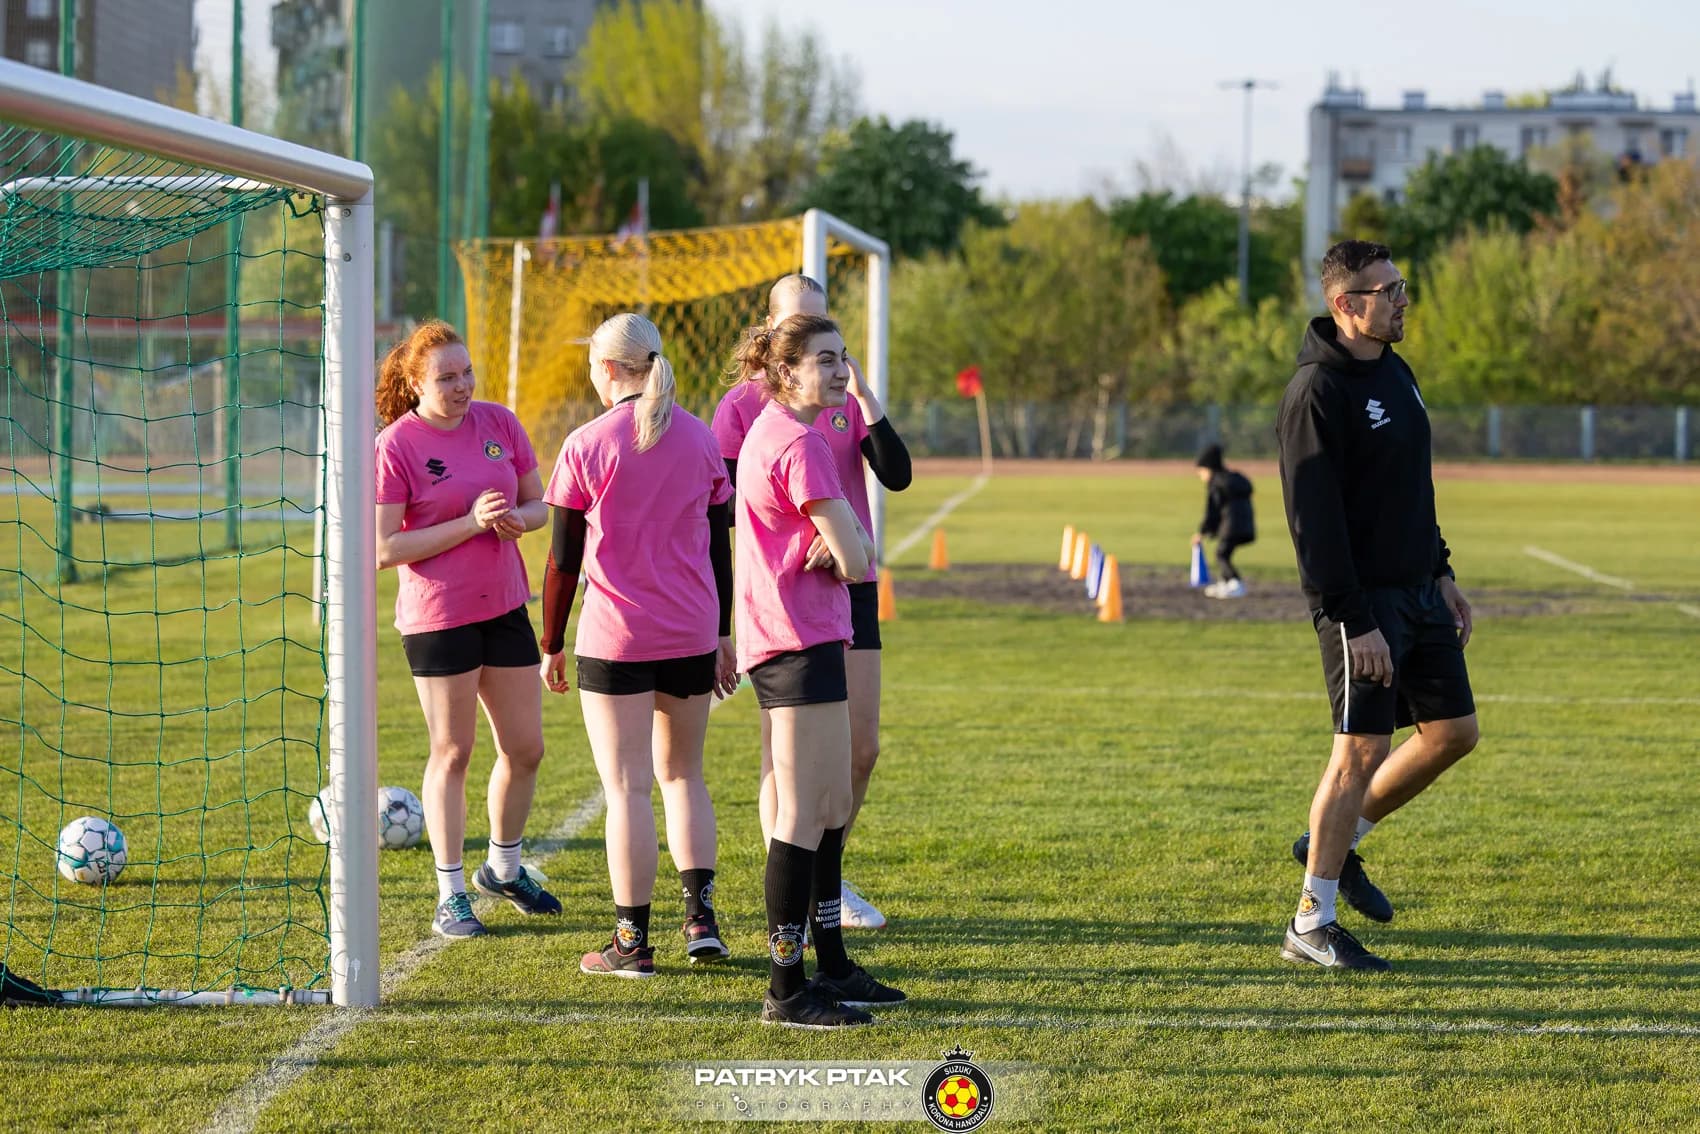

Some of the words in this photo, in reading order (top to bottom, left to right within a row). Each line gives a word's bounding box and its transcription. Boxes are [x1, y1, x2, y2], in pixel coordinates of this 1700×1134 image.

[818, 898, 840, 908] SUZUK
[817, 906, 840, 915] KORON
[822, 920, 840, 929] KIELC
